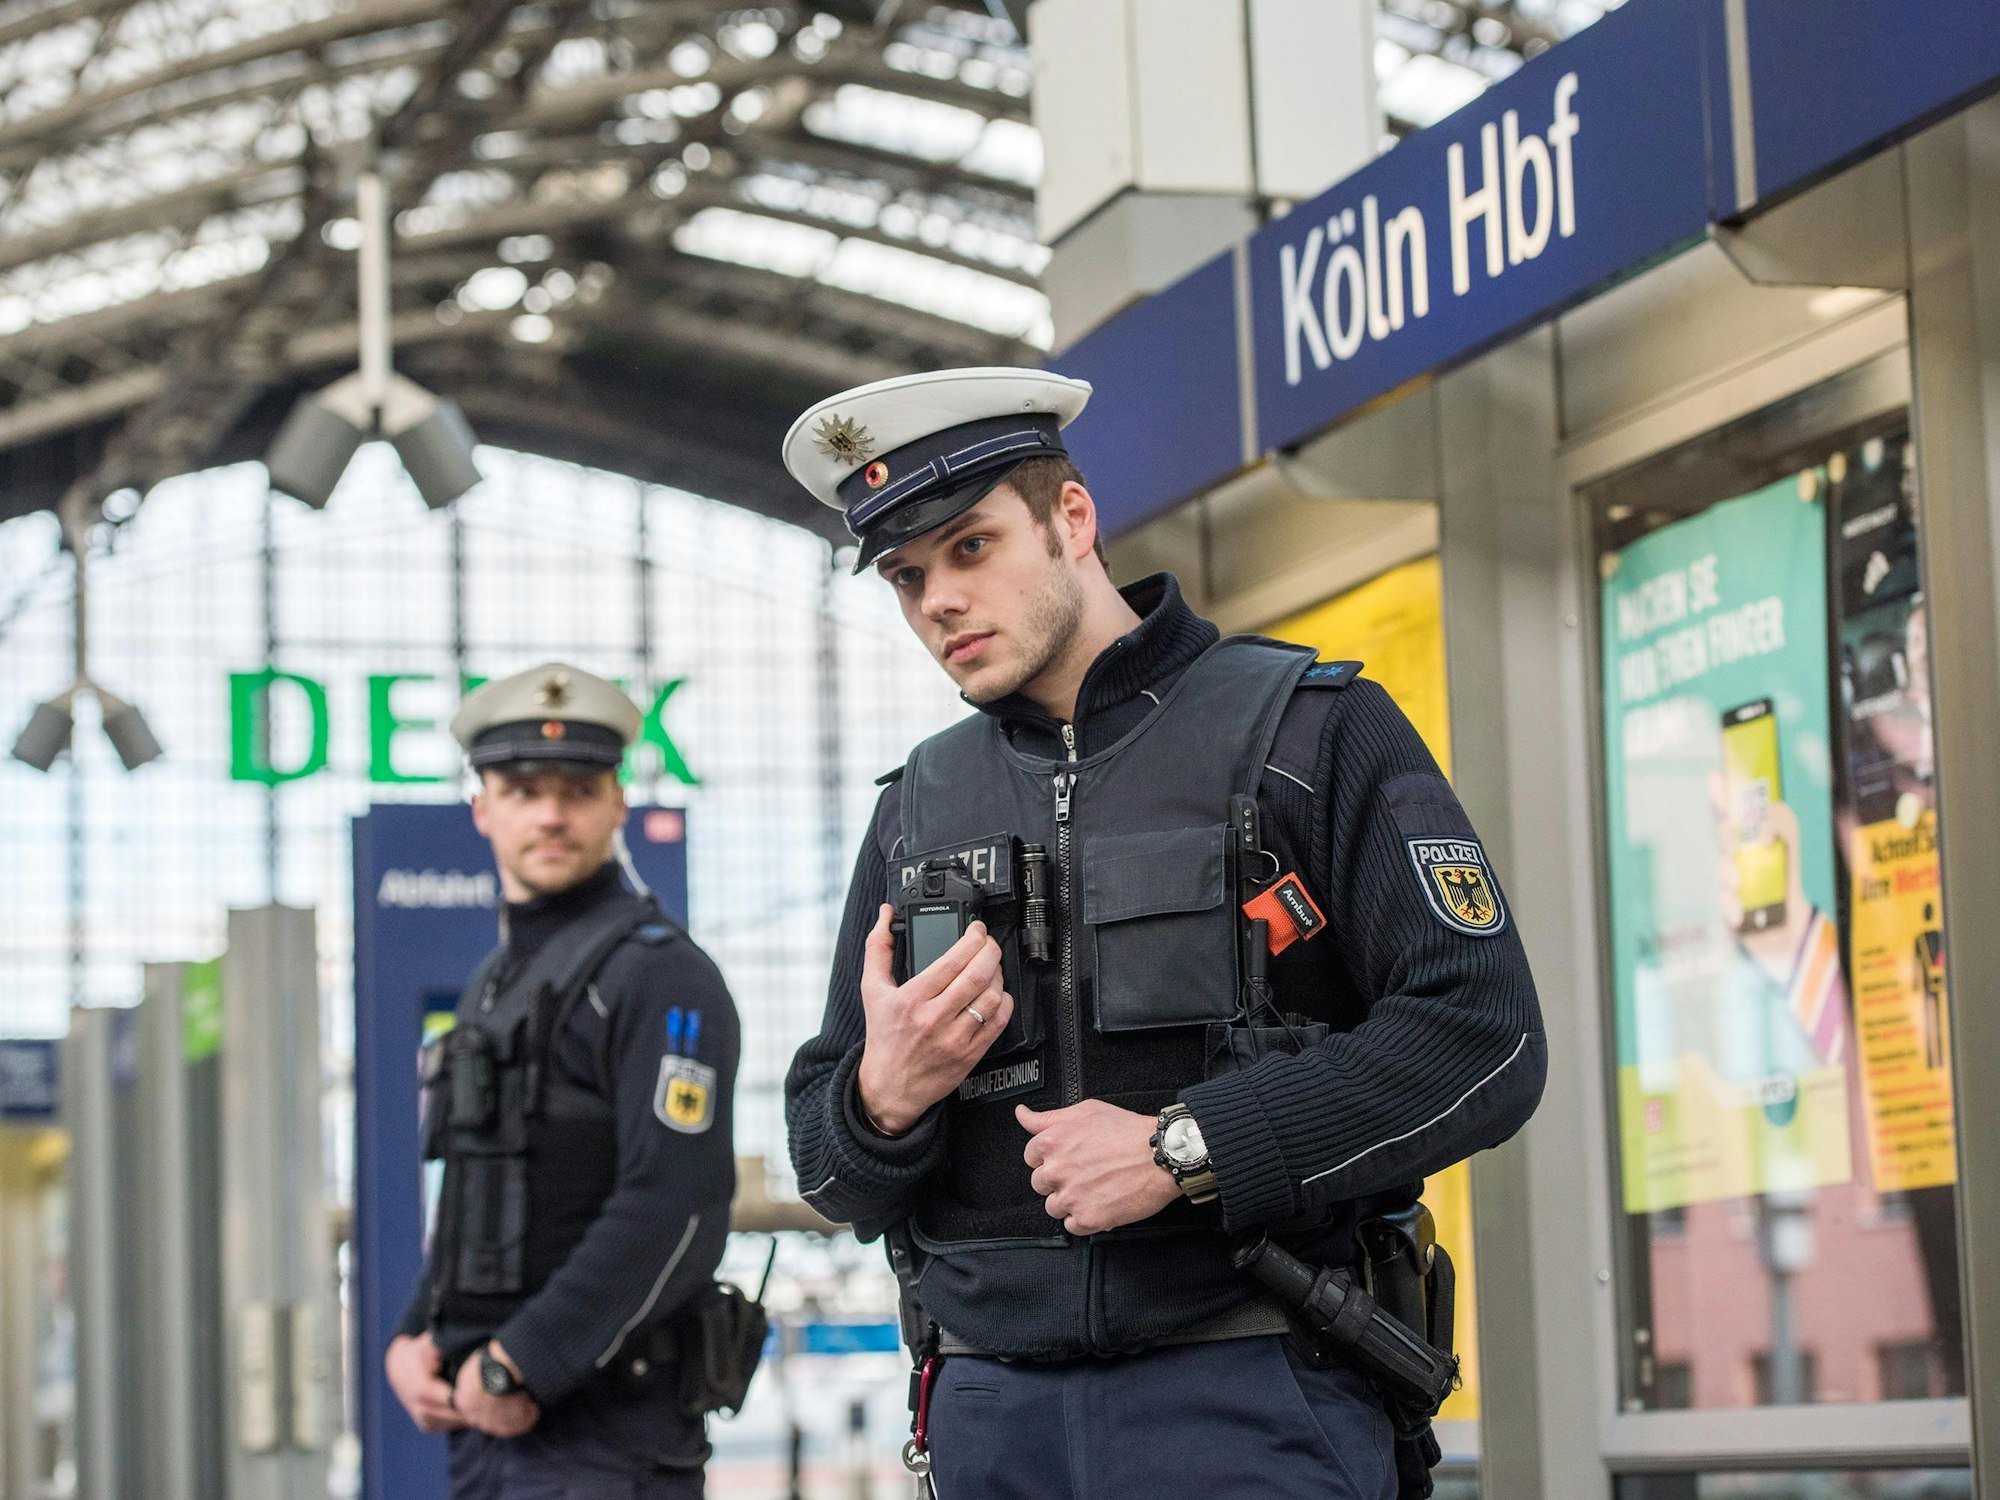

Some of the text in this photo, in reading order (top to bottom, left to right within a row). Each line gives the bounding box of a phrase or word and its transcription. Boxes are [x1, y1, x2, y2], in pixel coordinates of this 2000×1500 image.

[1279, 71, 1580, 386] Köln Hbf
[229, 671, 702, 786] DEK
[1418, 844, 1481, 865] POLIZEI
[919, 905, 950, 913] MOTOROLA
[1283, 889, 1308, 922] Ambu
